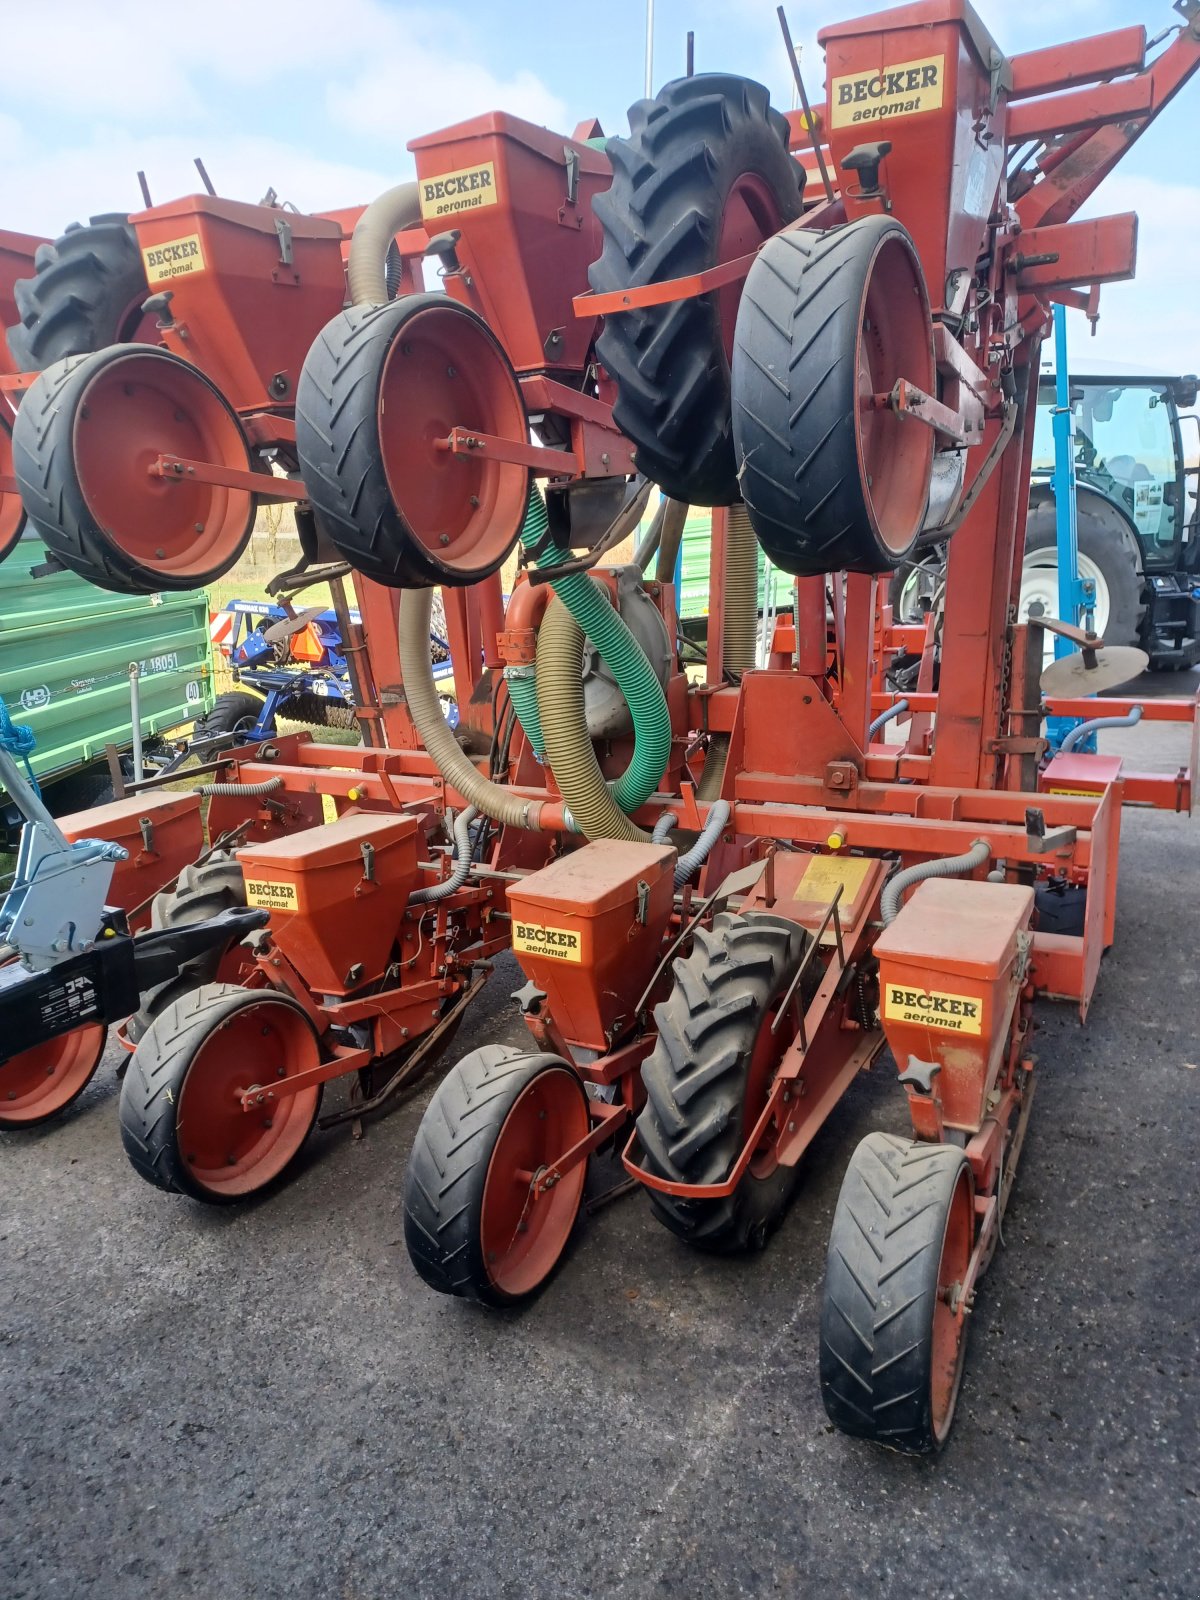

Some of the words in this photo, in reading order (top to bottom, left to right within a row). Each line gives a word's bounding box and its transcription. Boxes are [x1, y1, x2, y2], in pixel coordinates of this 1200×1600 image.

[838, 64, 938, 105] BECKER
[852, 96, 921, 121] aeromat
[424, 169, 492, 202] BECKER
[436, 193, 482, 214] aeromat
[147, 240, 199, 267] BECKER
[159, 261, 194, 278] aeromat
[150, 652, 179, 674] 18051
[188, 682, 198, 700] 40
[314, 681, 325, 695] 25
[248, 883, 295, 899] BECKER
[257, 899, 289, 908] aeromat
[516, 925, 578, 948] BECKER
[526, 944, 568, 958] aeromat
[891, 989, 978, 1018] BECKER
[903, 1012, 963, 1029] aeromat
